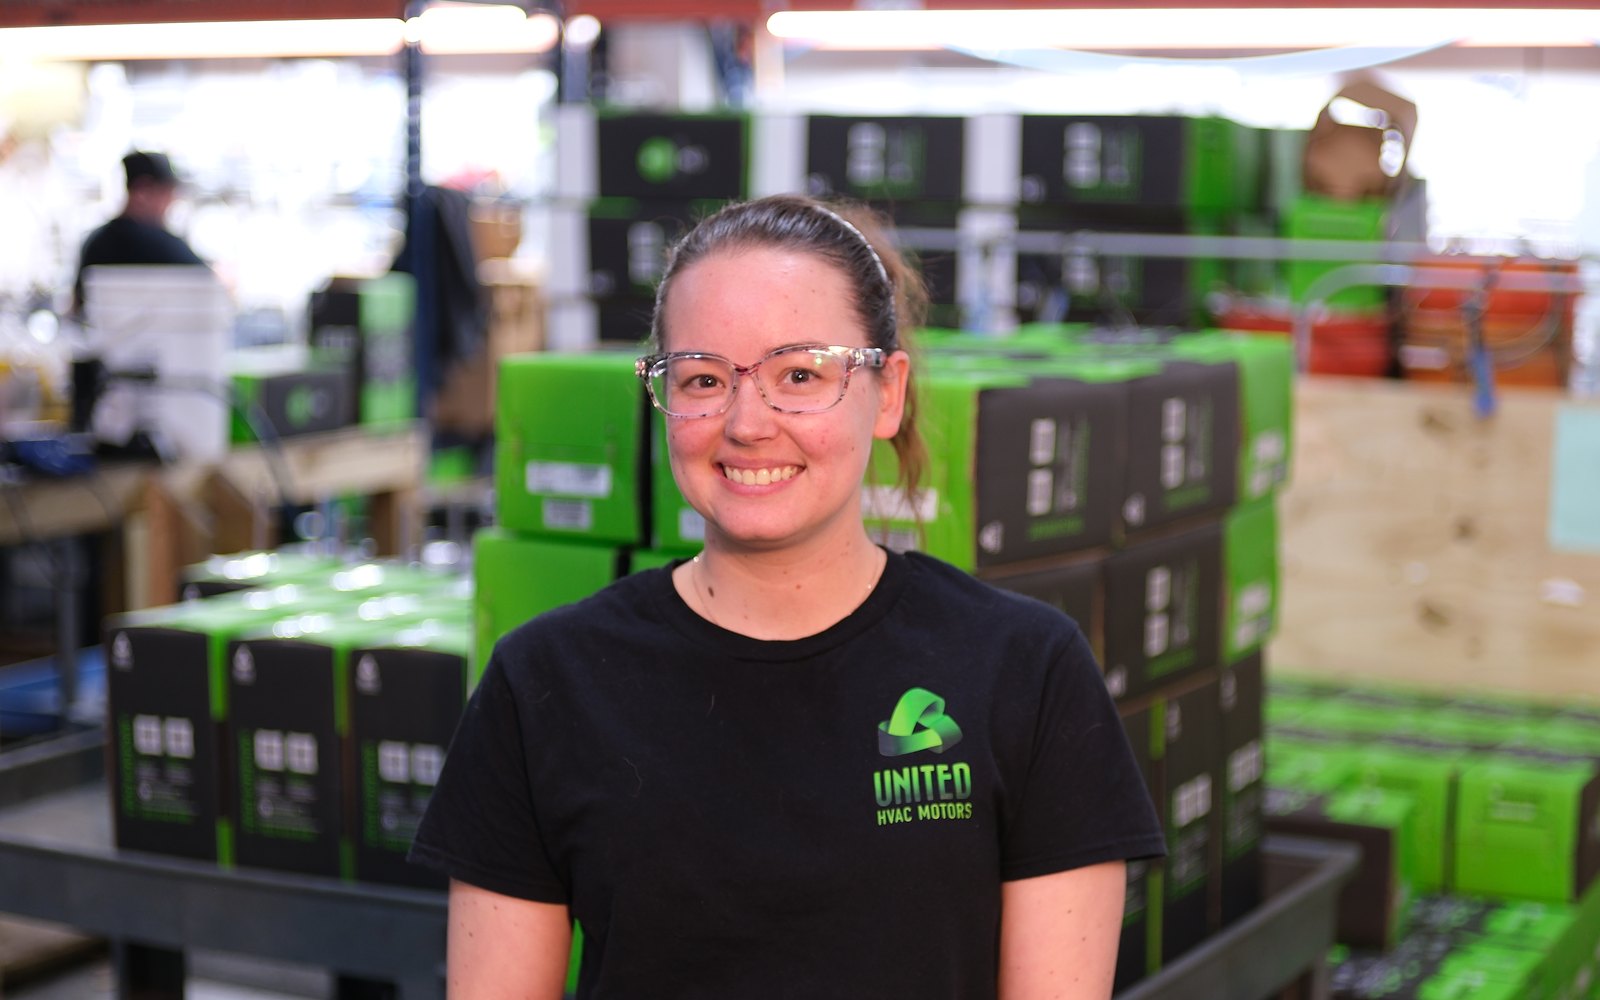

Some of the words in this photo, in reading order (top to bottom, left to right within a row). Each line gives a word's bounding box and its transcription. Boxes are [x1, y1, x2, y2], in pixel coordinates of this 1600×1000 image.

[873, 762, 972, 807] UNITED
[877, 806, 912, 826] HVAC
[917, 802, 973, 821] MOTORS
